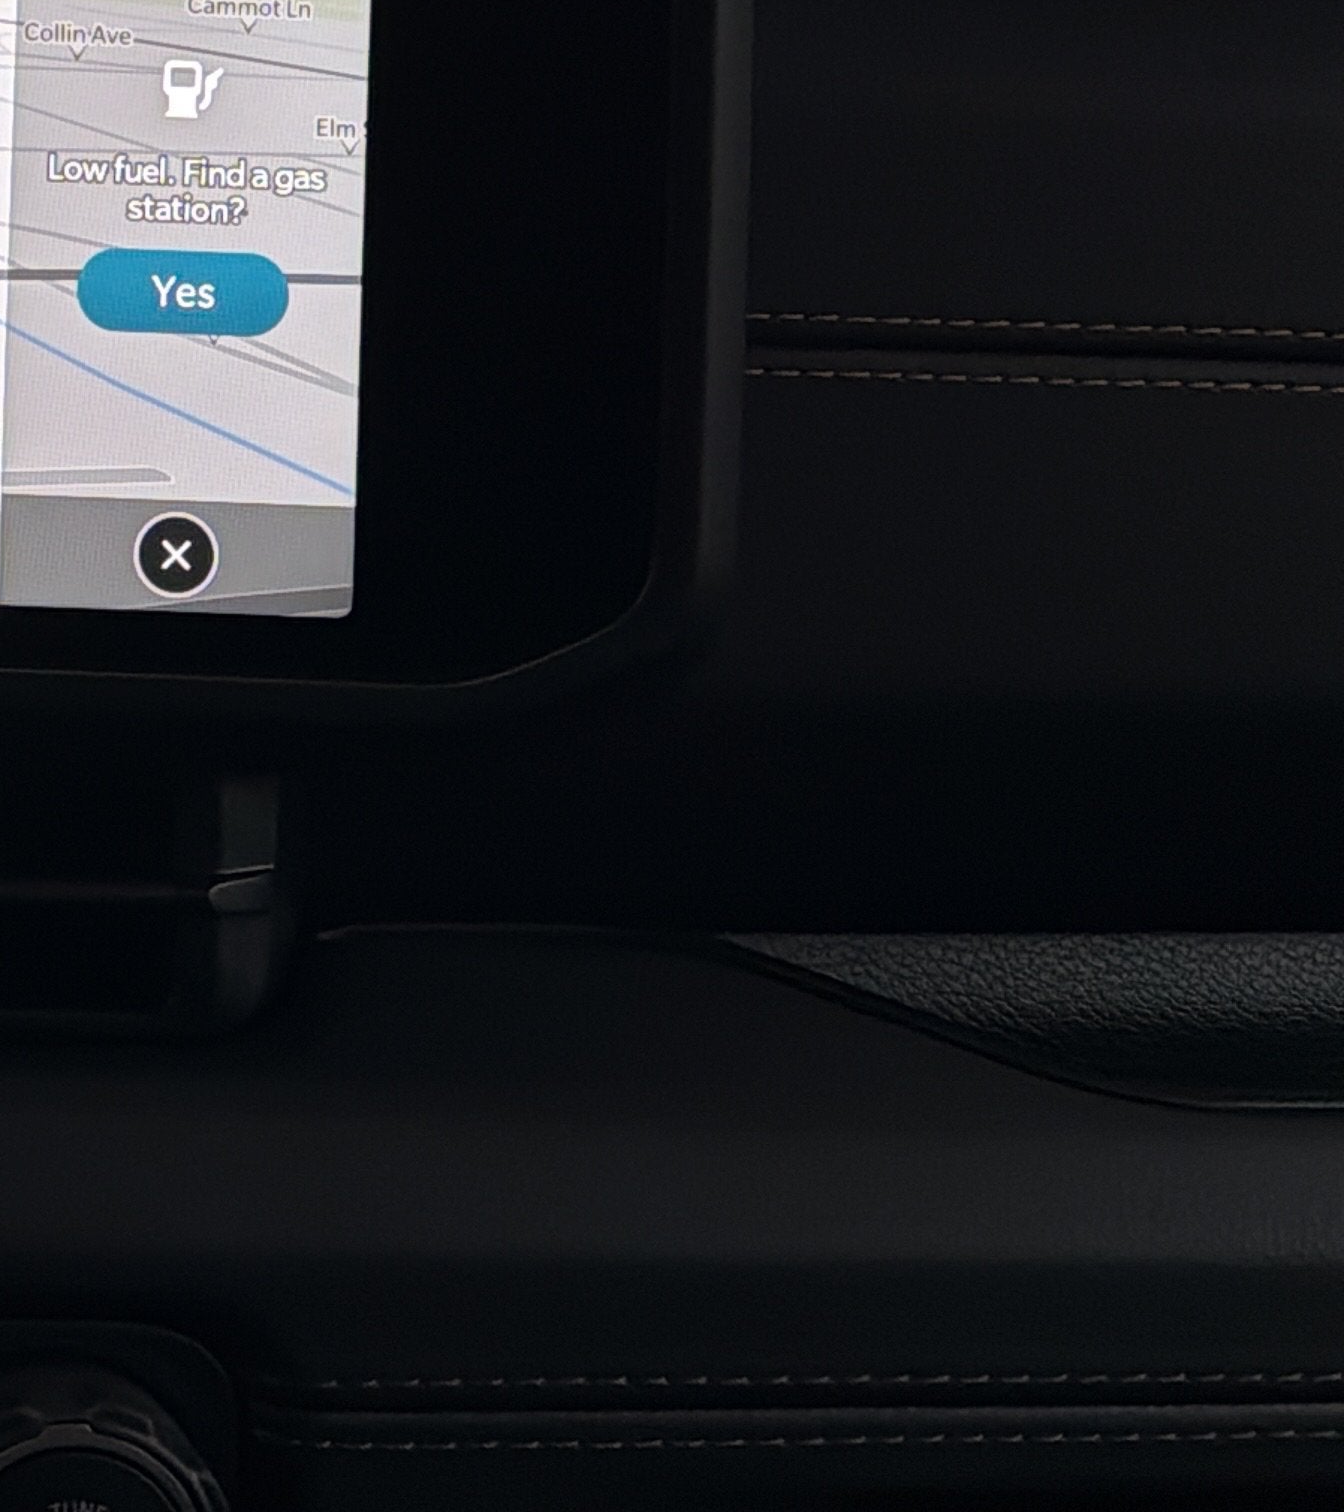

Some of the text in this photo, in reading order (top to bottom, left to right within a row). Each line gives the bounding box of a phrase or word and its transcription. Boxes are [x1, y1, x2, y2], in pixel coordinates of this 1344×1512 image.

[287, 0, 311, 19] Ln
[24, 23, 132, 46] Collin Ave
[316, 117, 356, 138] Elm
[47, 153, 327, 196] Low fuel. Find a gas
[126, 193, 247, 225] station?
[151, 275, 216, 310] Yes
